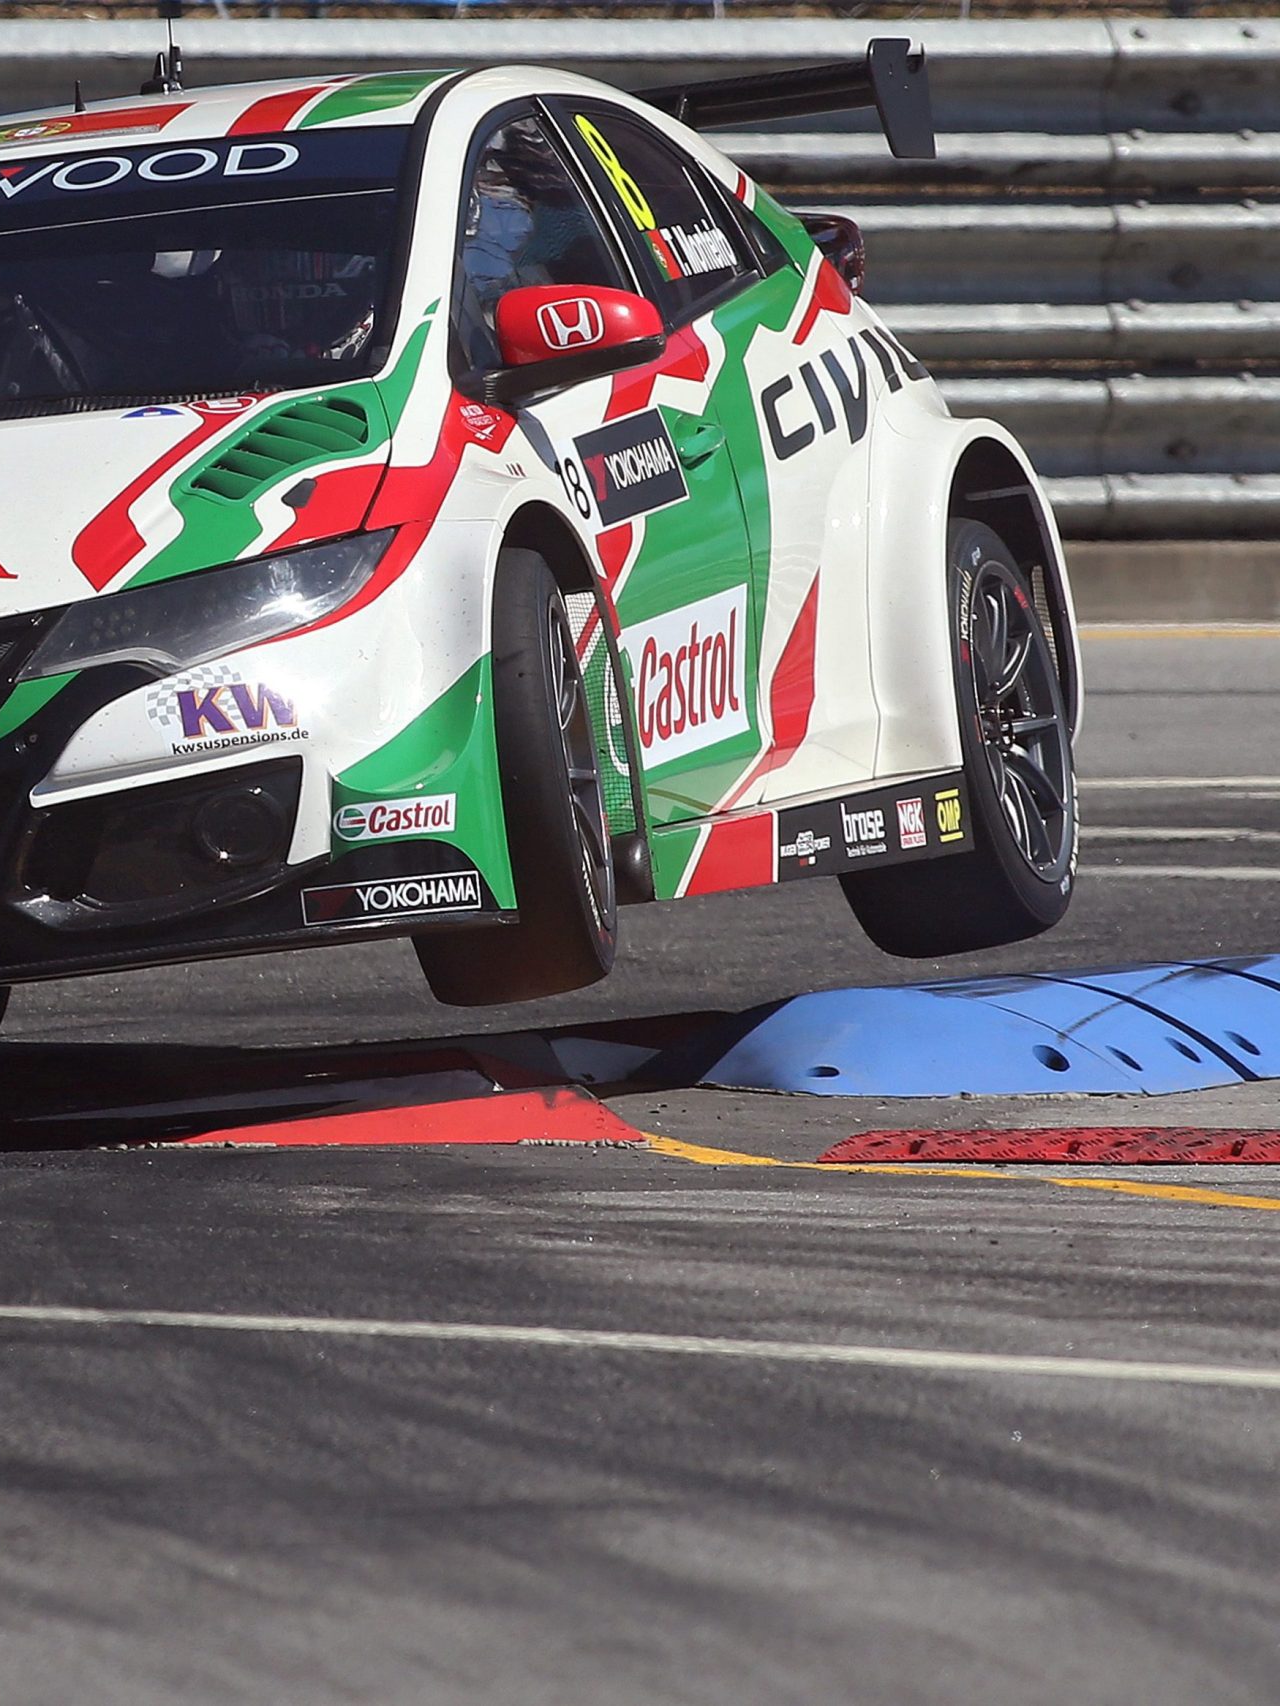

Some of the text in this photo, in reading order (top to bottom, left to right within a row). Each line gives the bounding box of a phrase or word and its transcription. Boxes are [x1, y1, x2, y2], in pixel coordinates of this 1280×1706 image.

[604, 437, 676, 490] YOKOHAMA
[638, 607, 739, 749] Castrol
[177, 682, 298, 740] KW
[172, 728, 309, 755] kwsuspensions.de
[368, 799, 451, 834] Castrol
[840, 802, 886, 844] brose
[897, 802, 925, 835] NGK
[936, 798, 962, 832] OMP
[356, 876, 477, 911] YOKOHAMA
